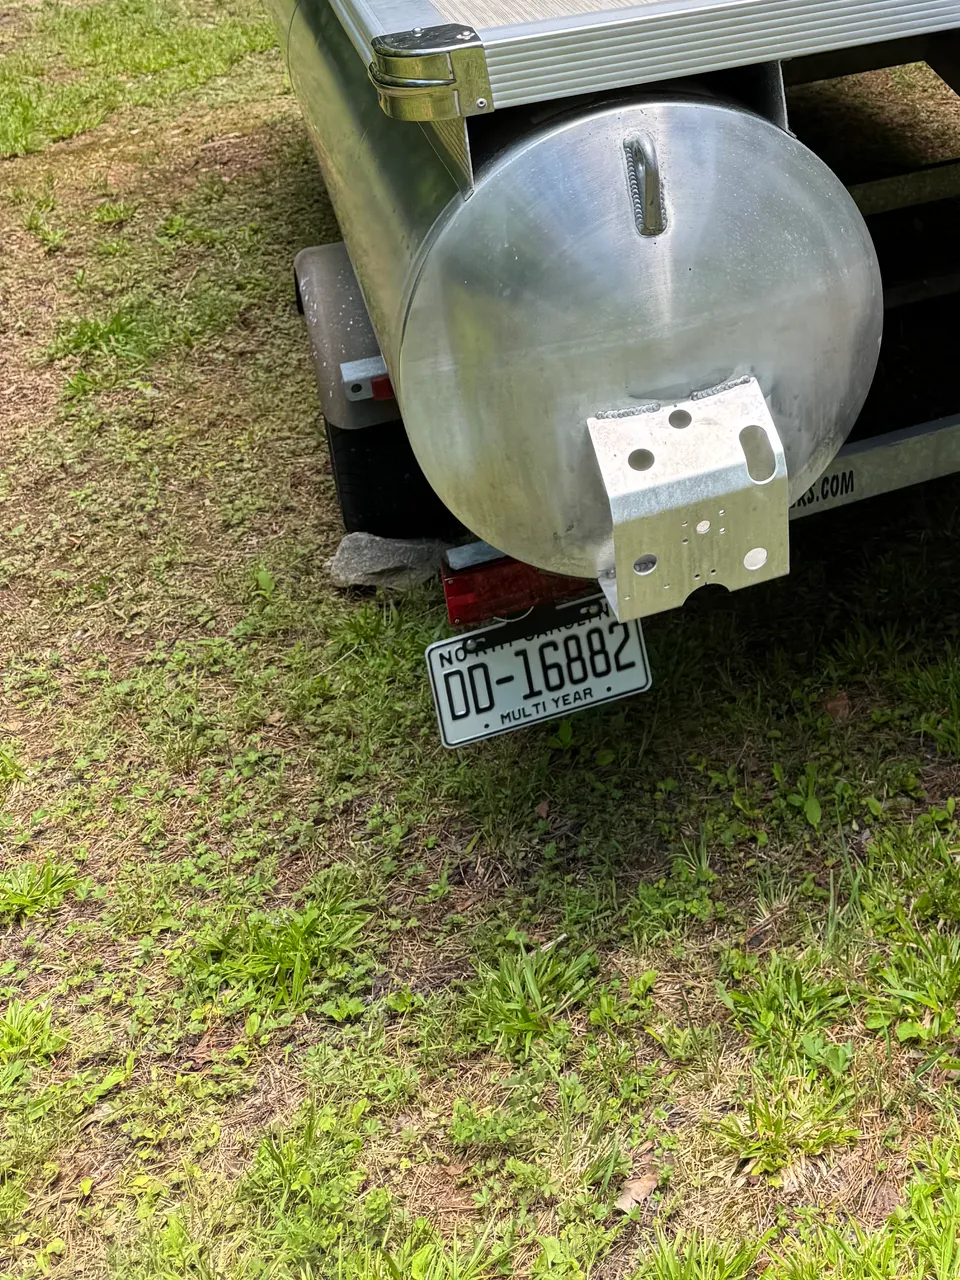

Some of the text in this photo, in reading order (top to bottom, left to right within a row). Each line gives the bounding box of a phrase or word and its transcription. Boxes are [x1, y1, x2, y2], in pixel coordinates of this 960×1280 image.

[789, 470, 854, 509] S.COM
[443, 622, 636, 720] DD-16882
[500, 687, 594, 725] MULTI YEAR
